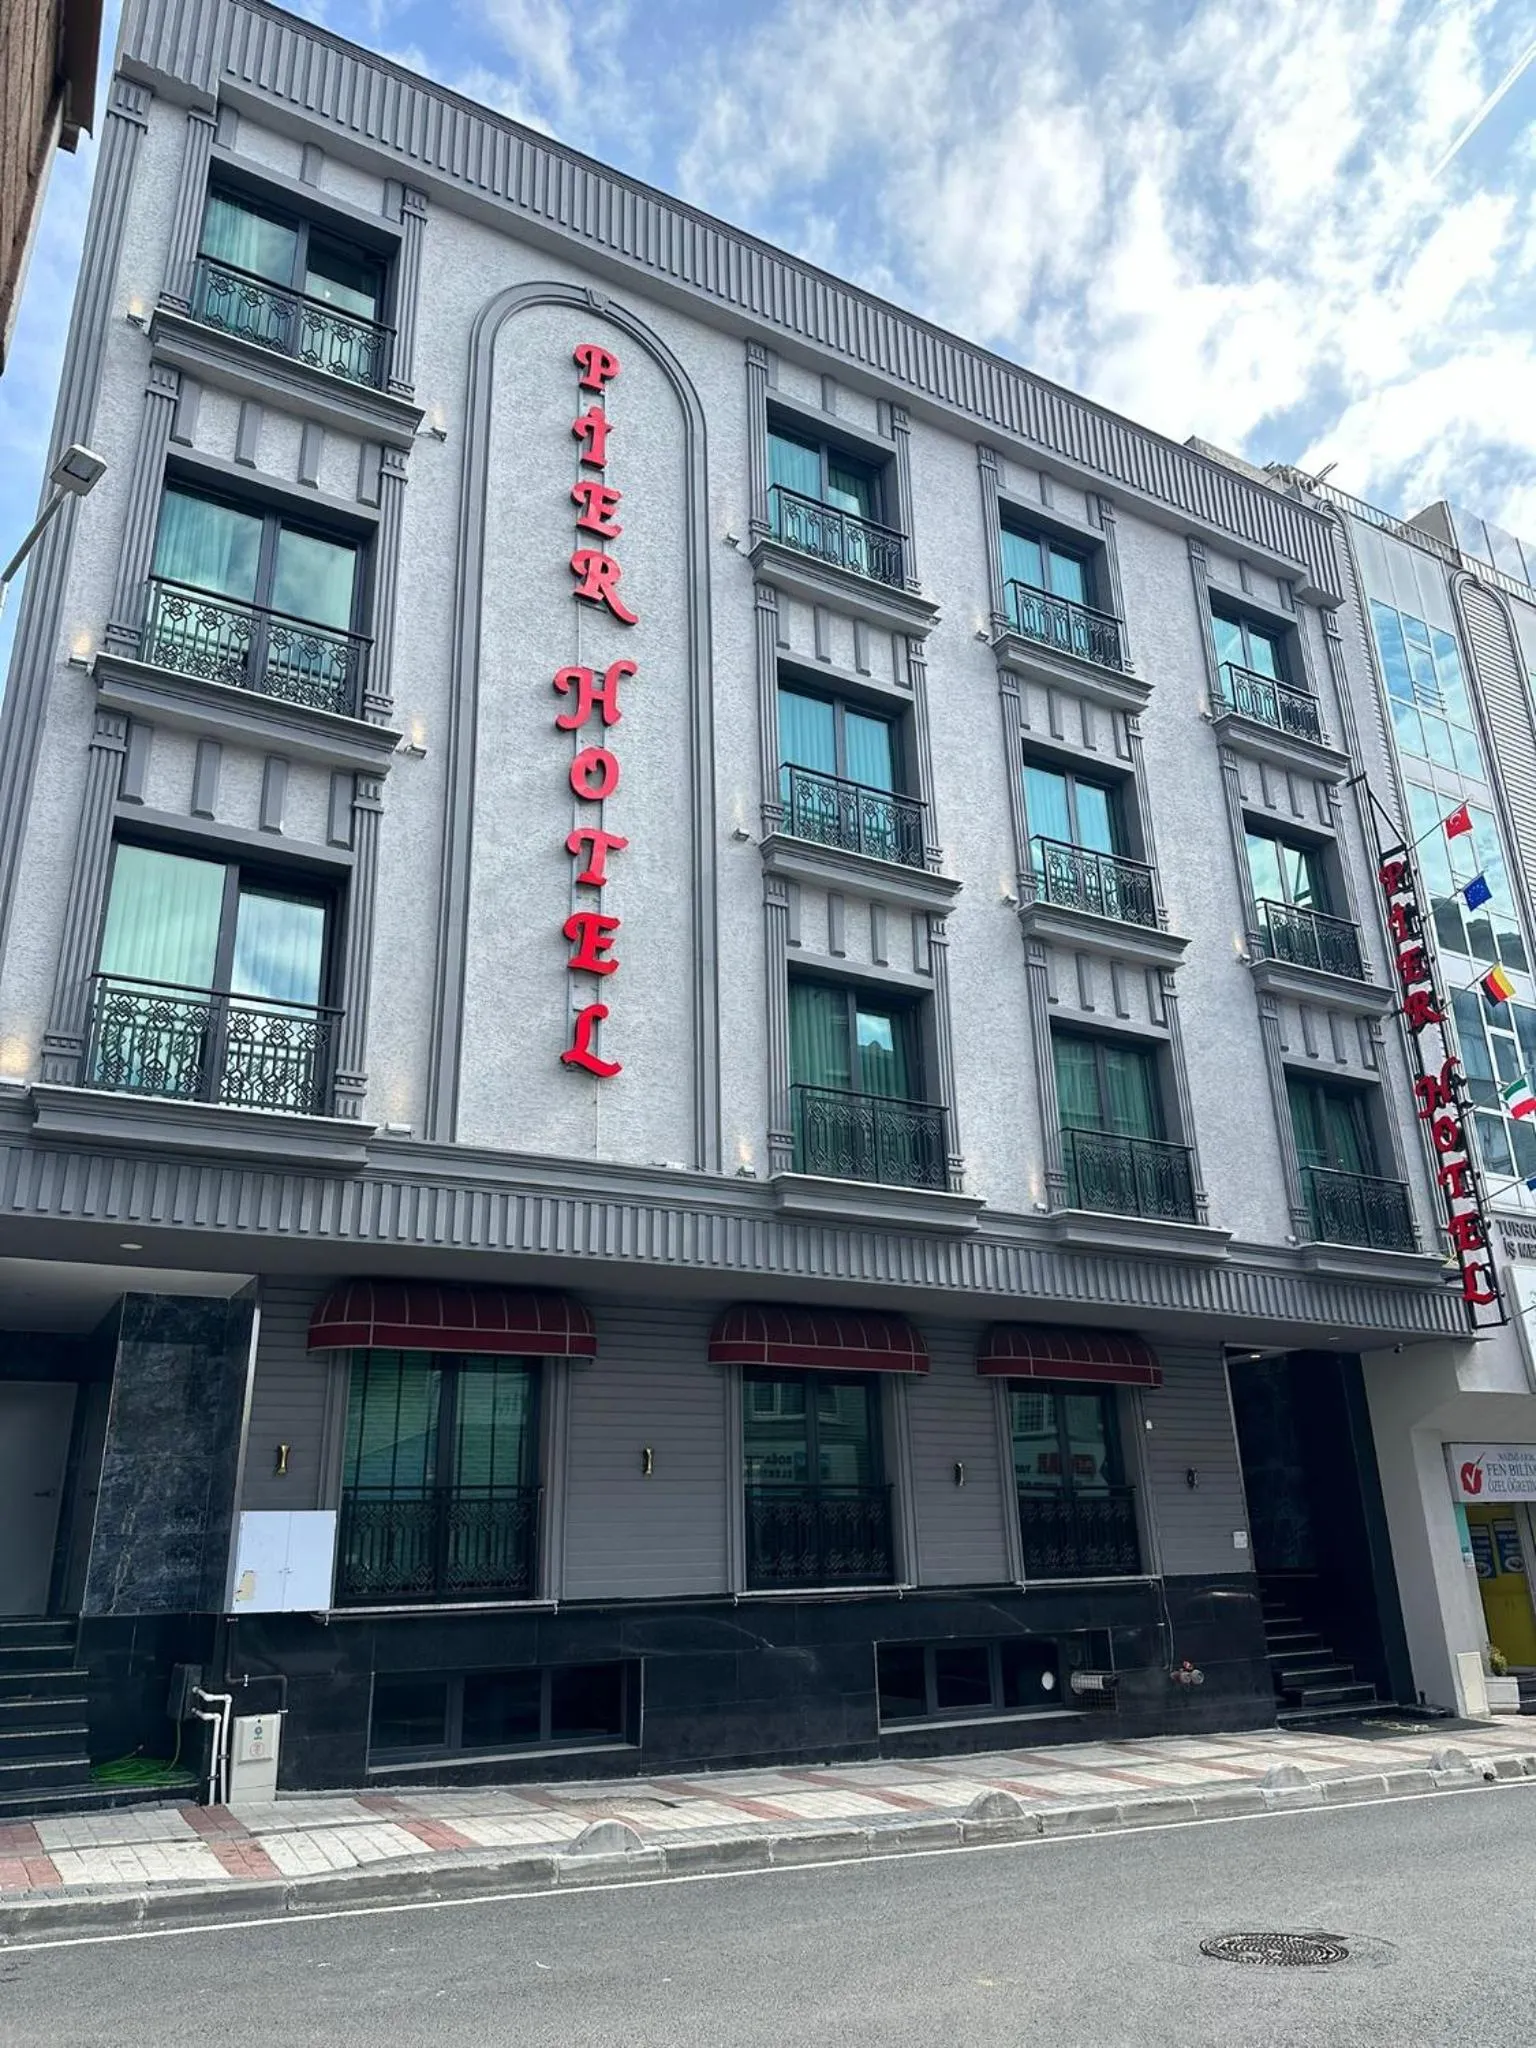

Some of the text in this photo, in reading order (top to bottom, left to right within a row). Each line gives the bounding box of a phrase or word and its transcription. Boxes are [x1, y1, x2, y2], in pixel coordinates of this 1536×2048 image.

[552, 659, 638, 1079] HOTEL
[1414, 1055, 1498, 1305] HOTEL
[1486, 1463, 1507, 1476] FEN
